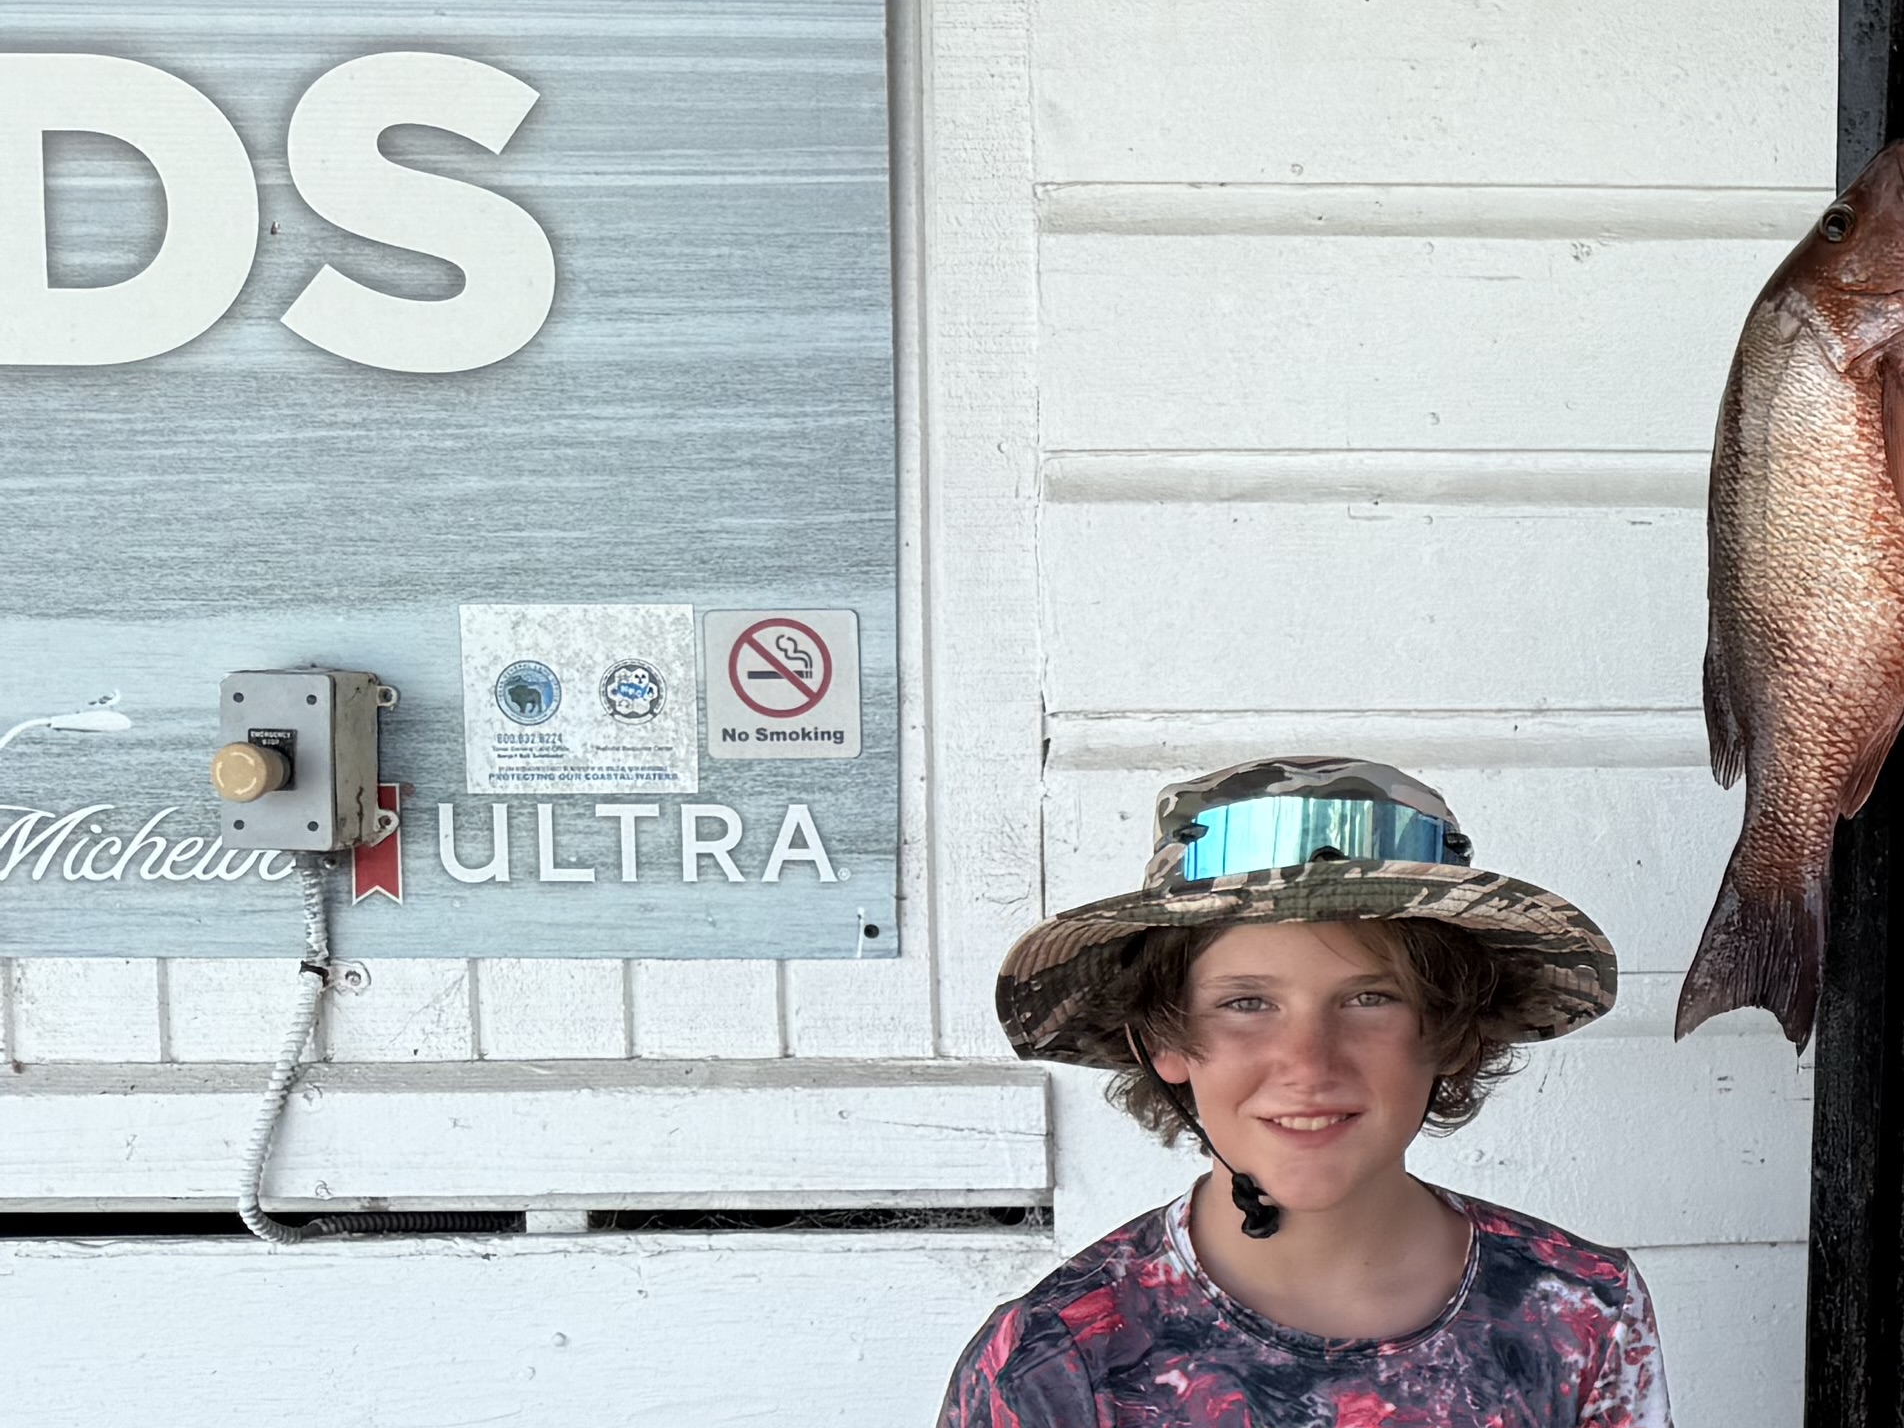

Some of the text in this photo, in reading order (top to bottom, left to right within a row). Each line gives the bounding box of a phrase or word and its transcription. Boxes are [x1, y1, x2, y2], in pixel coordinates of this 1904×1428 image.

[722, 726, 845, 745] No Smoking
[438, 803, 839, 883] ULTRA
